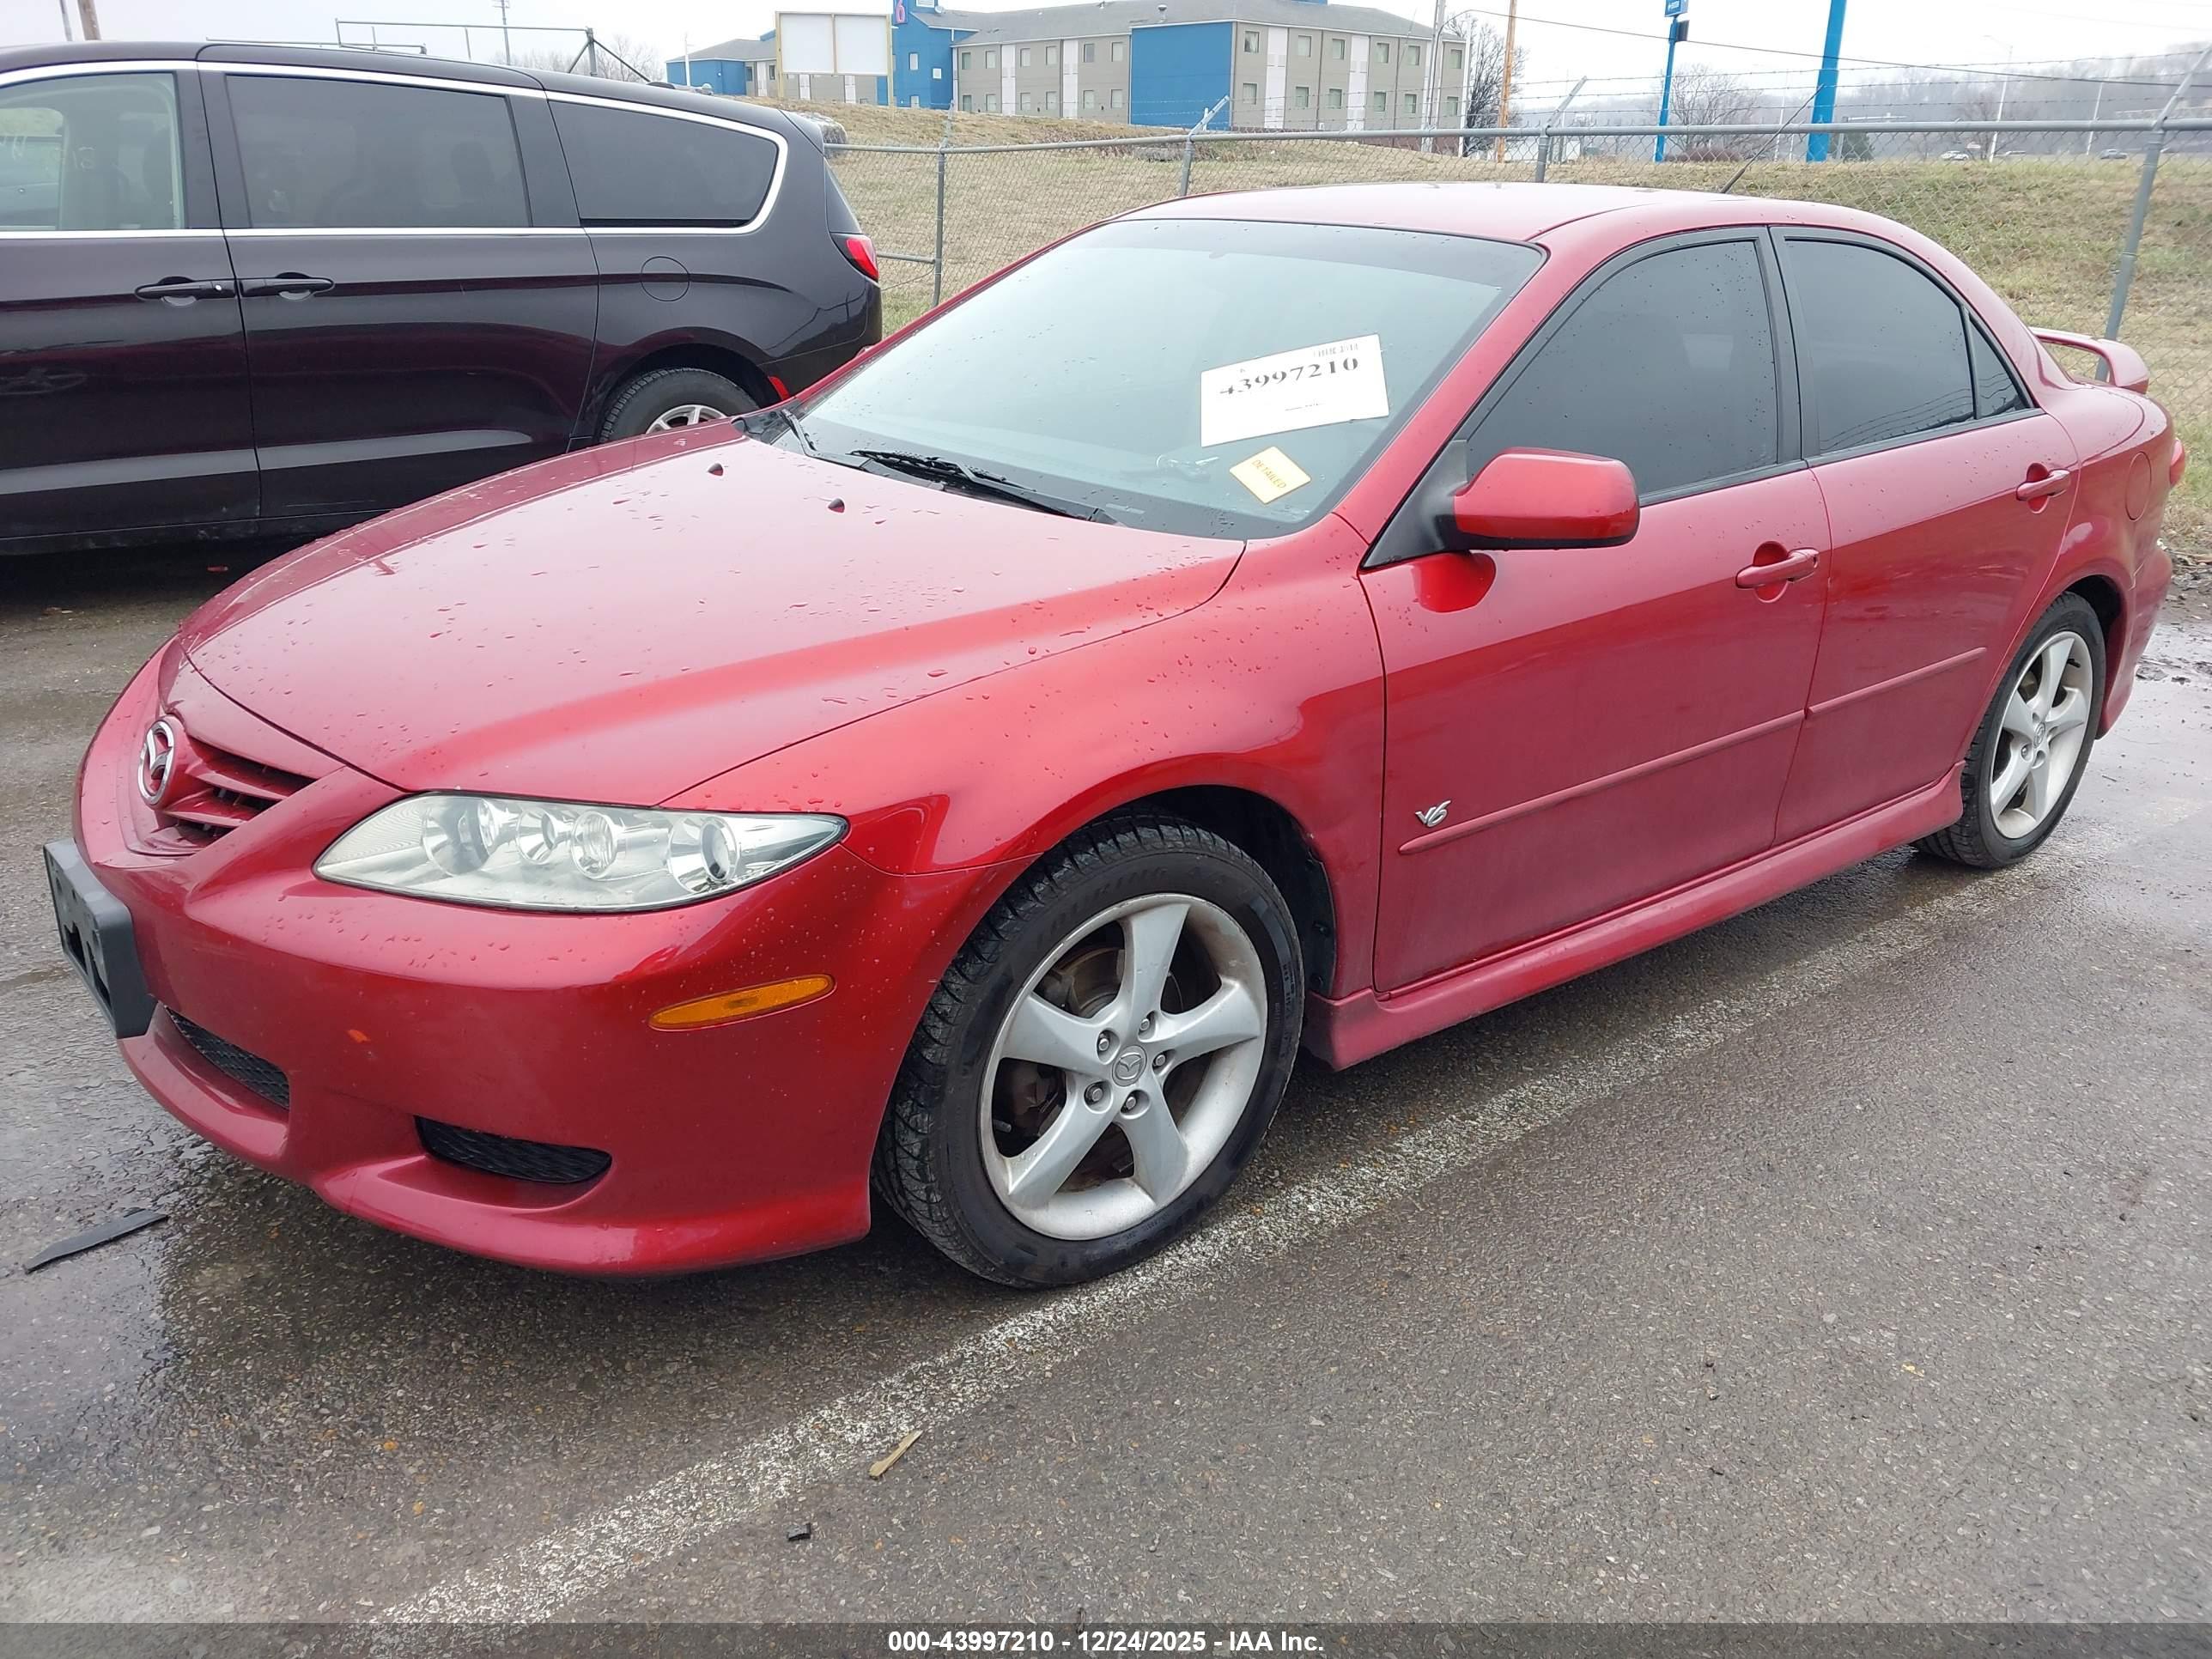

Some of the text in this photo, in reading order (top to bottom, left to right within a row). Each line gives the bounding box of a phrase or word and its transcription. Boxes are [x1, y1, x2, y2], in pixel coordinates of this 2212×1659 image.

[1220, 357, 1358, 394] 43997210
[1252, 459, 1286, 489] DETAILED
[1414, 799, 1451, 828] V6
